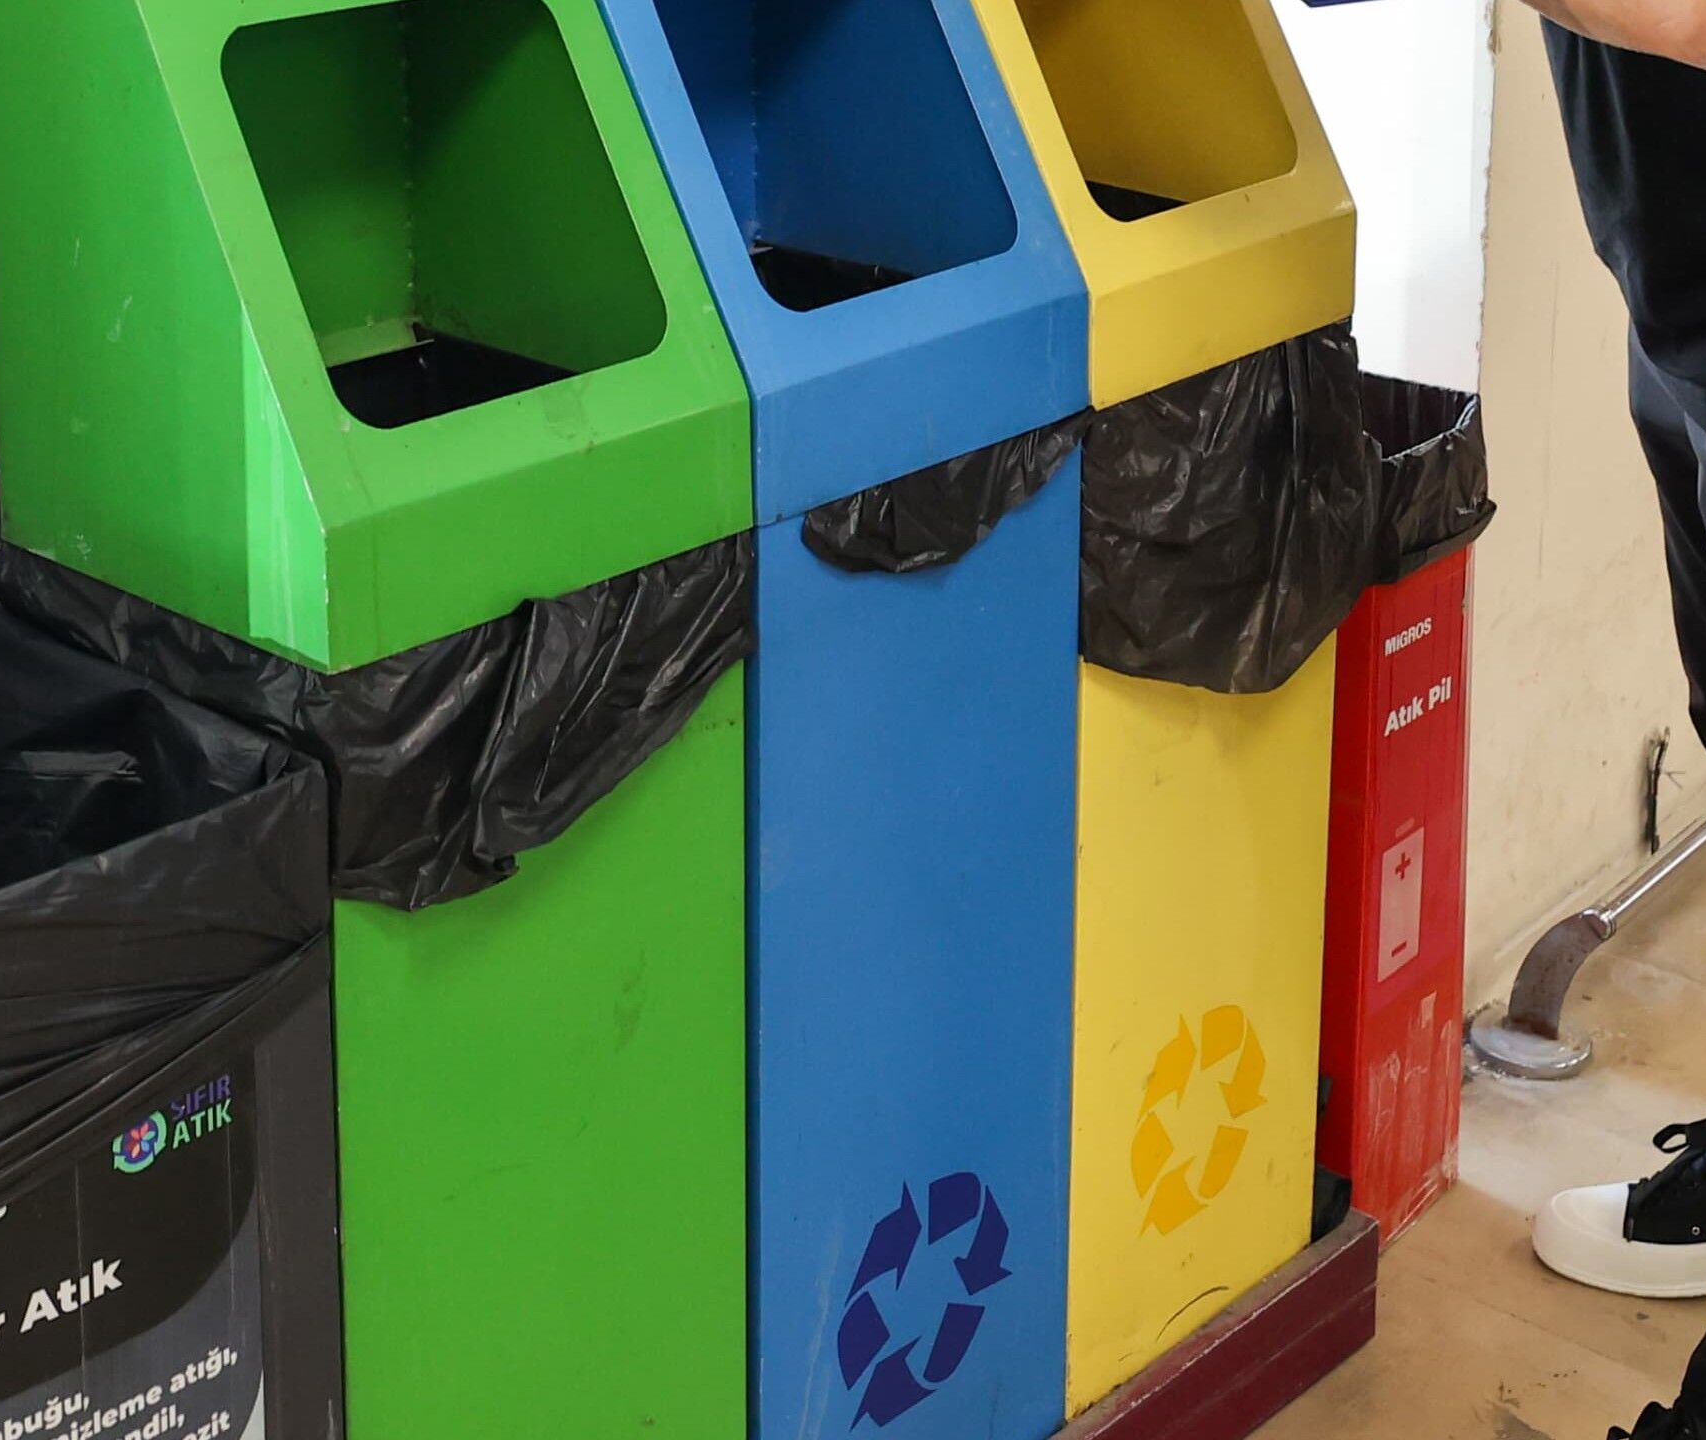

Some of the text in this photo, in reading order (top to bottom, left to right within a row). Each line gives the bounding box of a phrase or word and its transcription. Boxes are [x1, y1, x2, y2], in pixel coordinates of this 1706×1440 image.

[1383, 676, 1452, 737] Atık Pil
[170, 1073, 231, 1119] SIFIR
[172, 1097, 233, 1150] ATIK
[19, 1257, 124, 1336] Atık
[169, 1346, 239, 1394] atığı,
